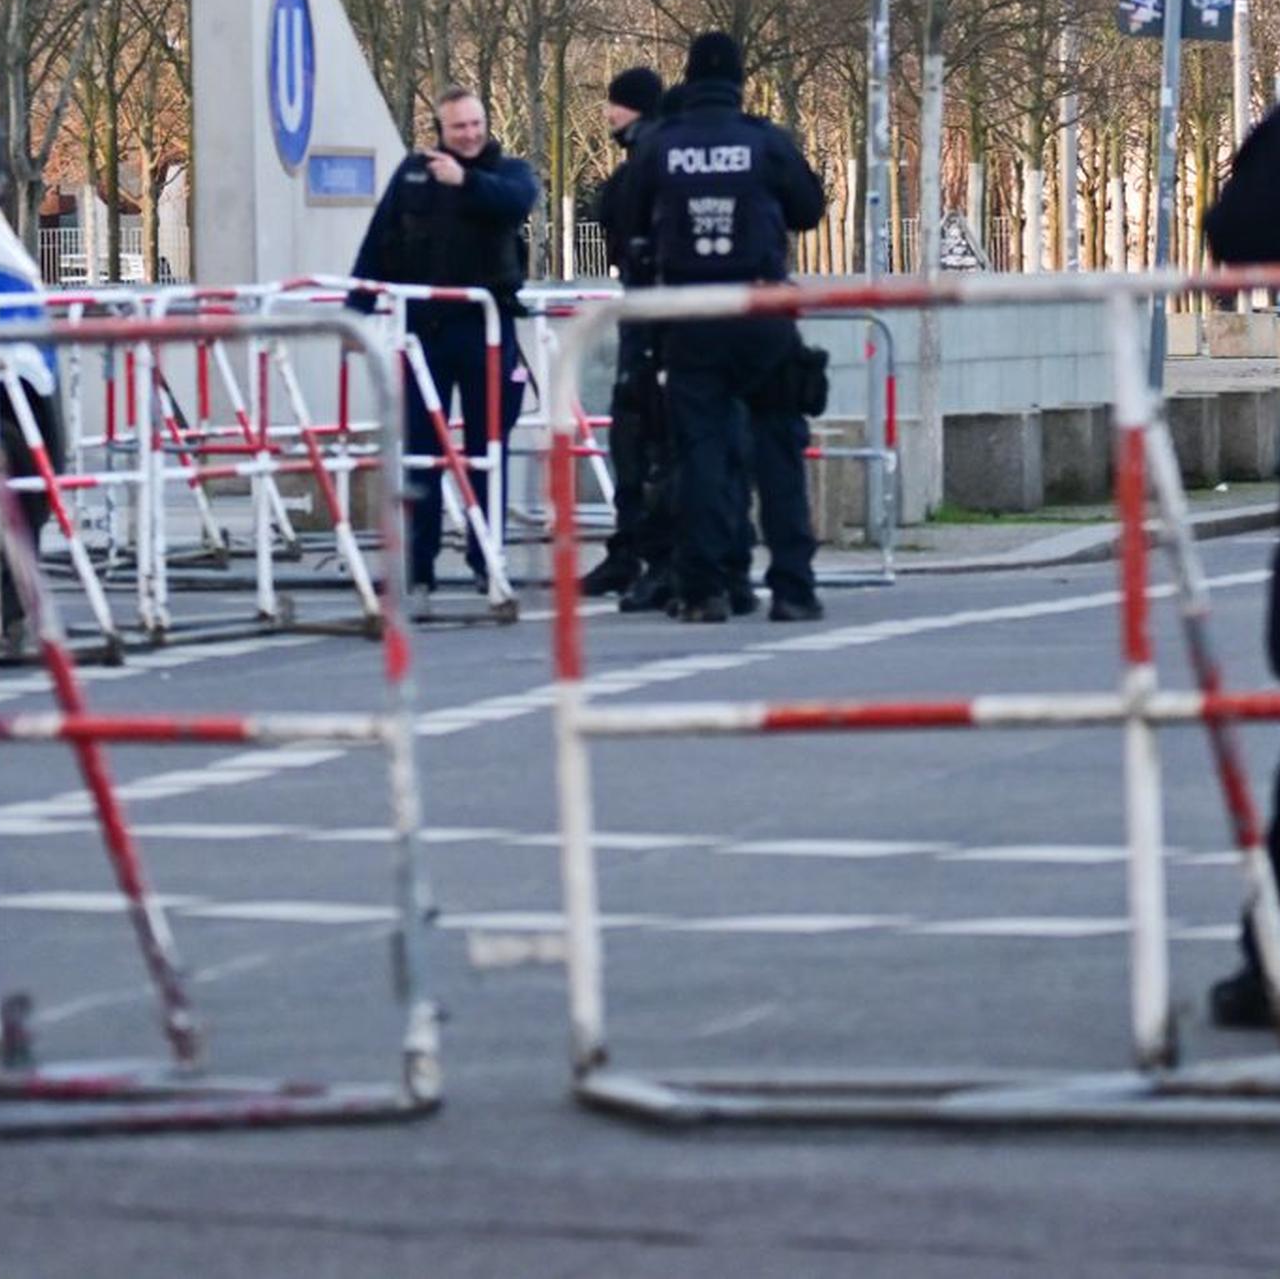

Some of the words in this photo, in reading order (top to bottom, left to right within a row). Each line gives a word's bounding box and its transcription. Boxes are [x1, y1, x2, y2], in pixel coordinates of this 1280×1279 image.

[276, 7, 305, 134] U
[667, 146, 752, 174] POLIZEI
[688, 198, 736, 216] NRW
